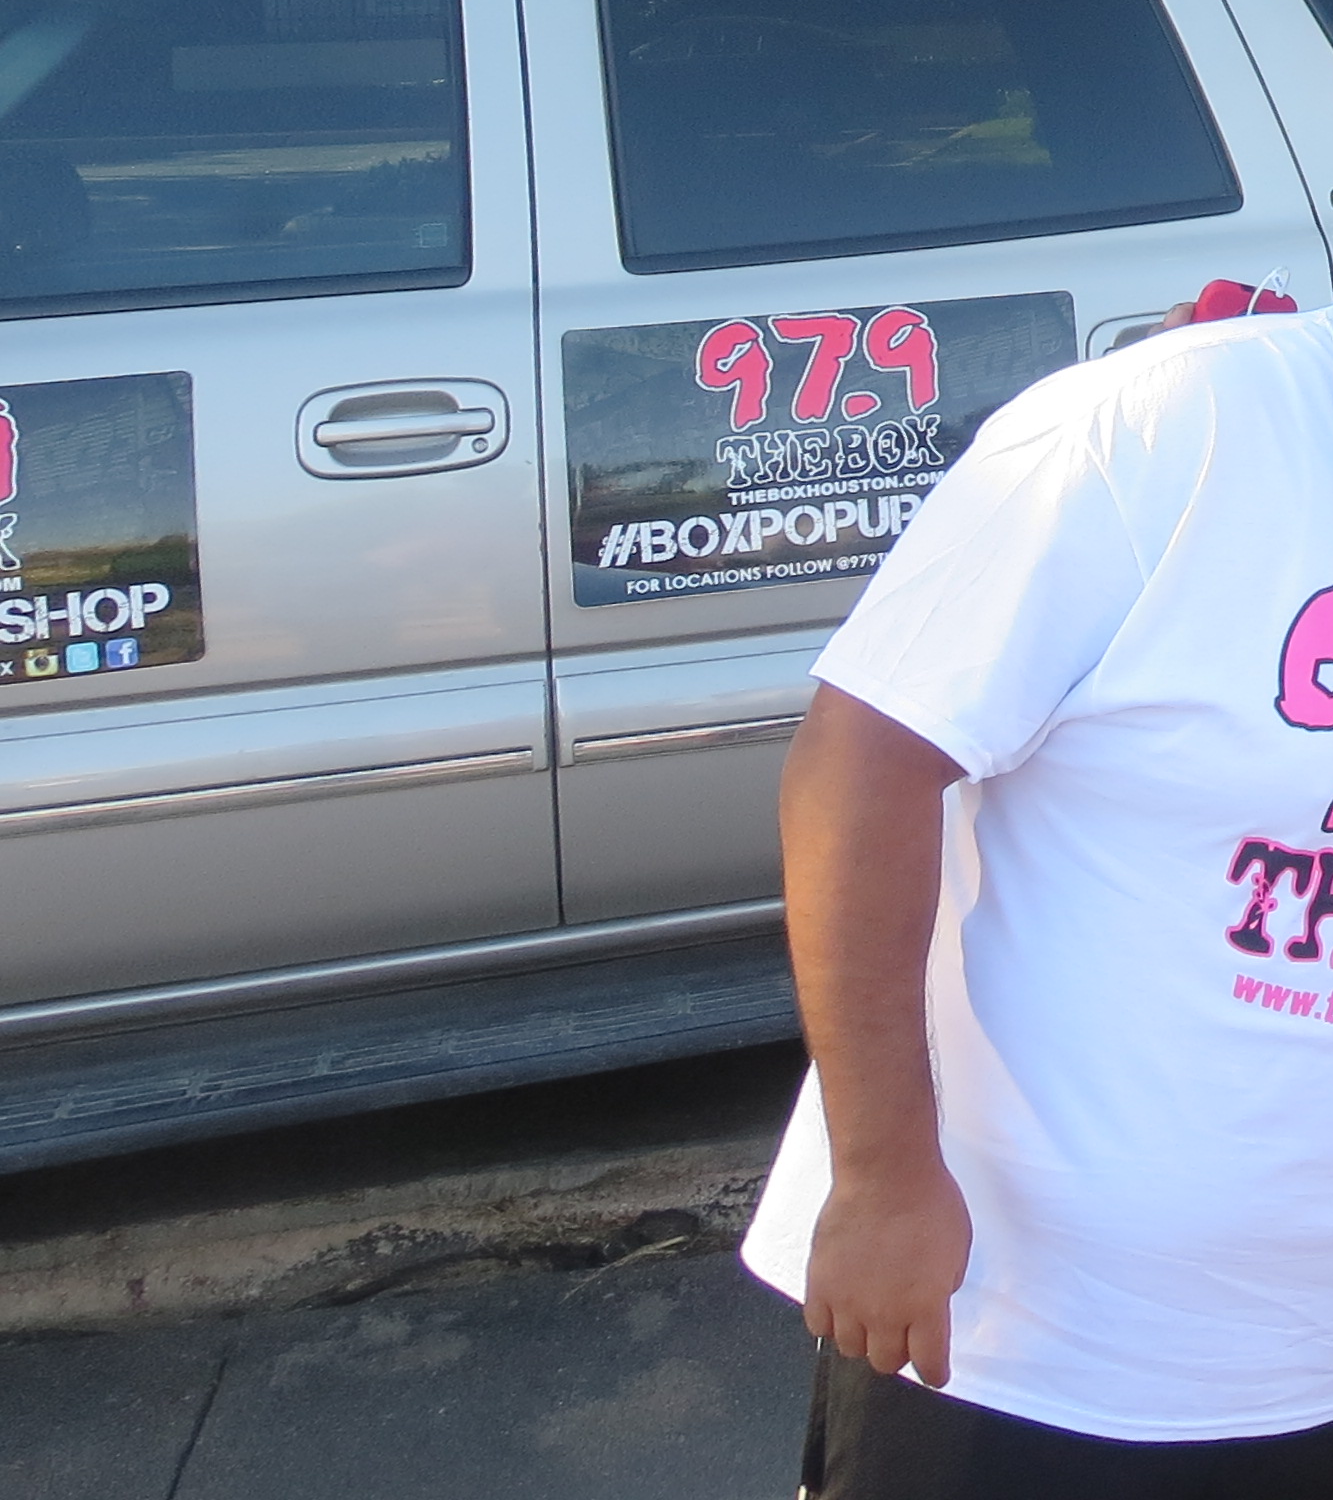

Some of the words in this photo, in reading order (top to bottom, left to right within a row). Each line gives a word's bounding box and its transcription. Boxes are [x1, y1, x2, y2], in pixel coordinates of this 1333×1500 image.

[695, 304, 941, 432] 97.9
[716, 425, 833, 489] THE
[833, 414, 945, 480] BOX
[727, 471, 945, 507] THEBOXHOUSTON.COM
[626, 579, 661, 595] FOR
[664, 565, 762, 591] LOCATIONS
[765, 557, 833, 579] FOLLOW
